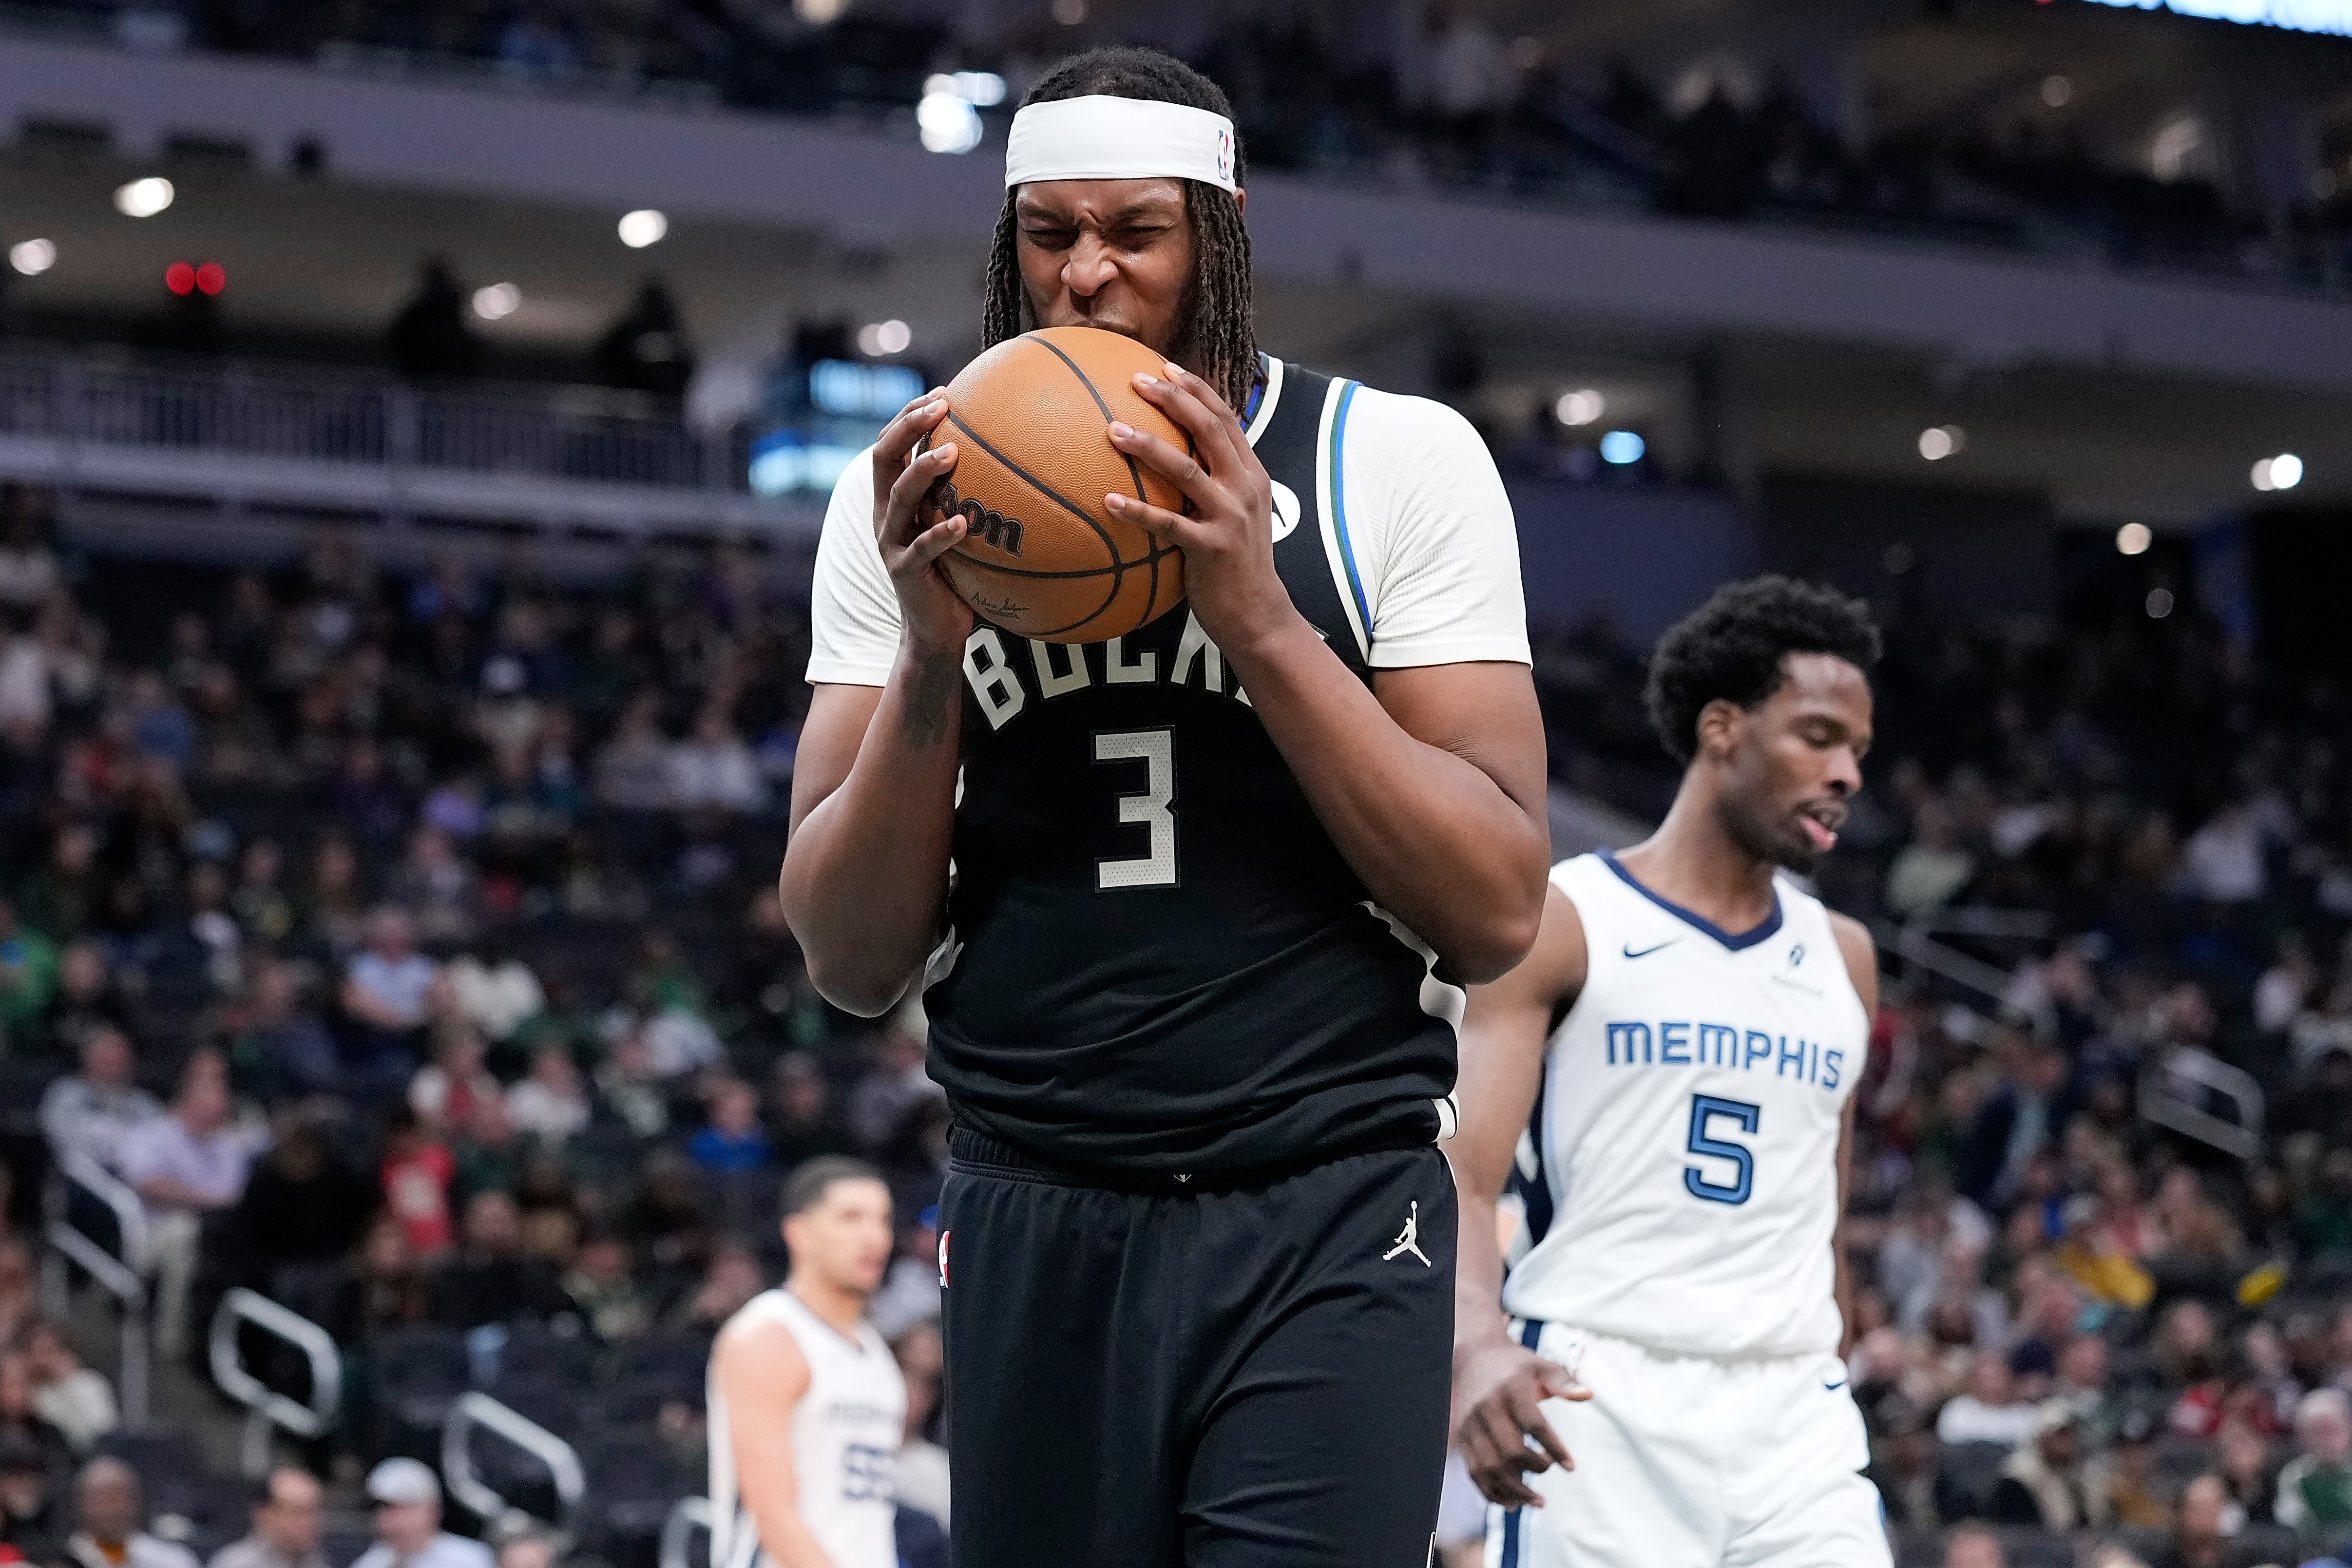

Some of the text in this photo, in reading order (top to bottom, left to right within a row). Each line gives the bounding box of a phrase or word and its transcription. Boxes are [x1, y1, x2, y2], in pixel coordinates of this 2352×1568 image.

[962, 608, 1254, 731] BUCK
[1094, 728, 1177, 890] 3
[1605, 1022, 1845, 1090] MEMPHIS
[1684, 1093, 1760, 1206] 5
